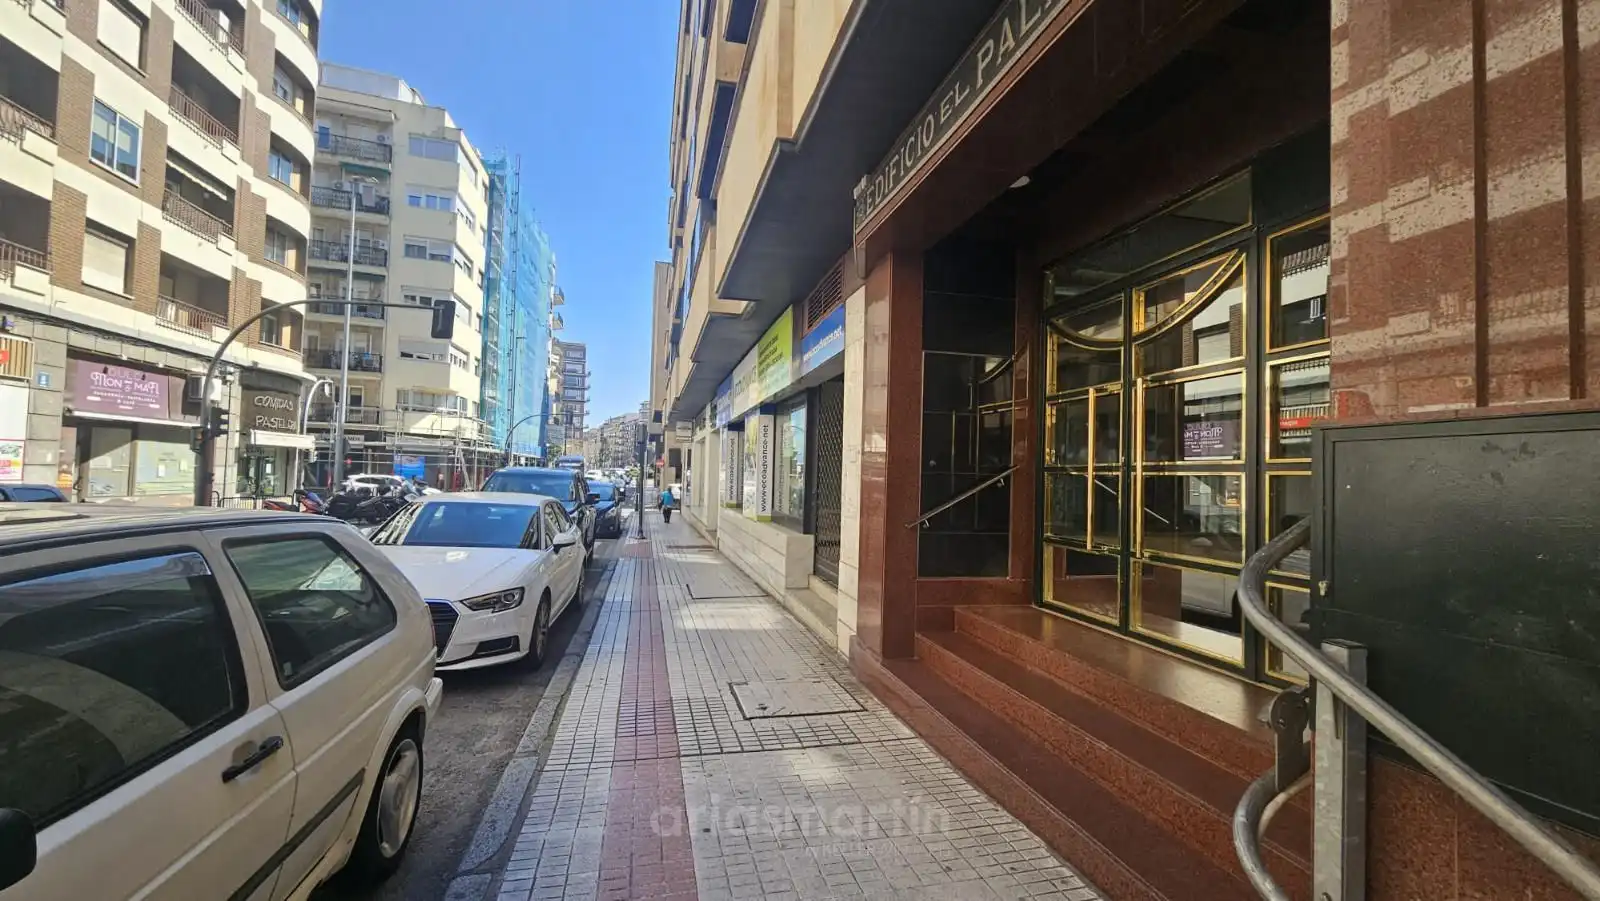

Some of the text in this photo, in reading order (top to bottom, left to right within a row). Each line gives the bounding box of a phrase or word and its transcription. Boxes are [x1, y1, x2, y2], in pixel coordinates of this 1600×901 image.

[866, 0, 1052, 215] EDIFICIO EL PAL
[254, 395, 294, 411] COMIDAS
[761, 424, 769, 512] www.ecoadvance.net
